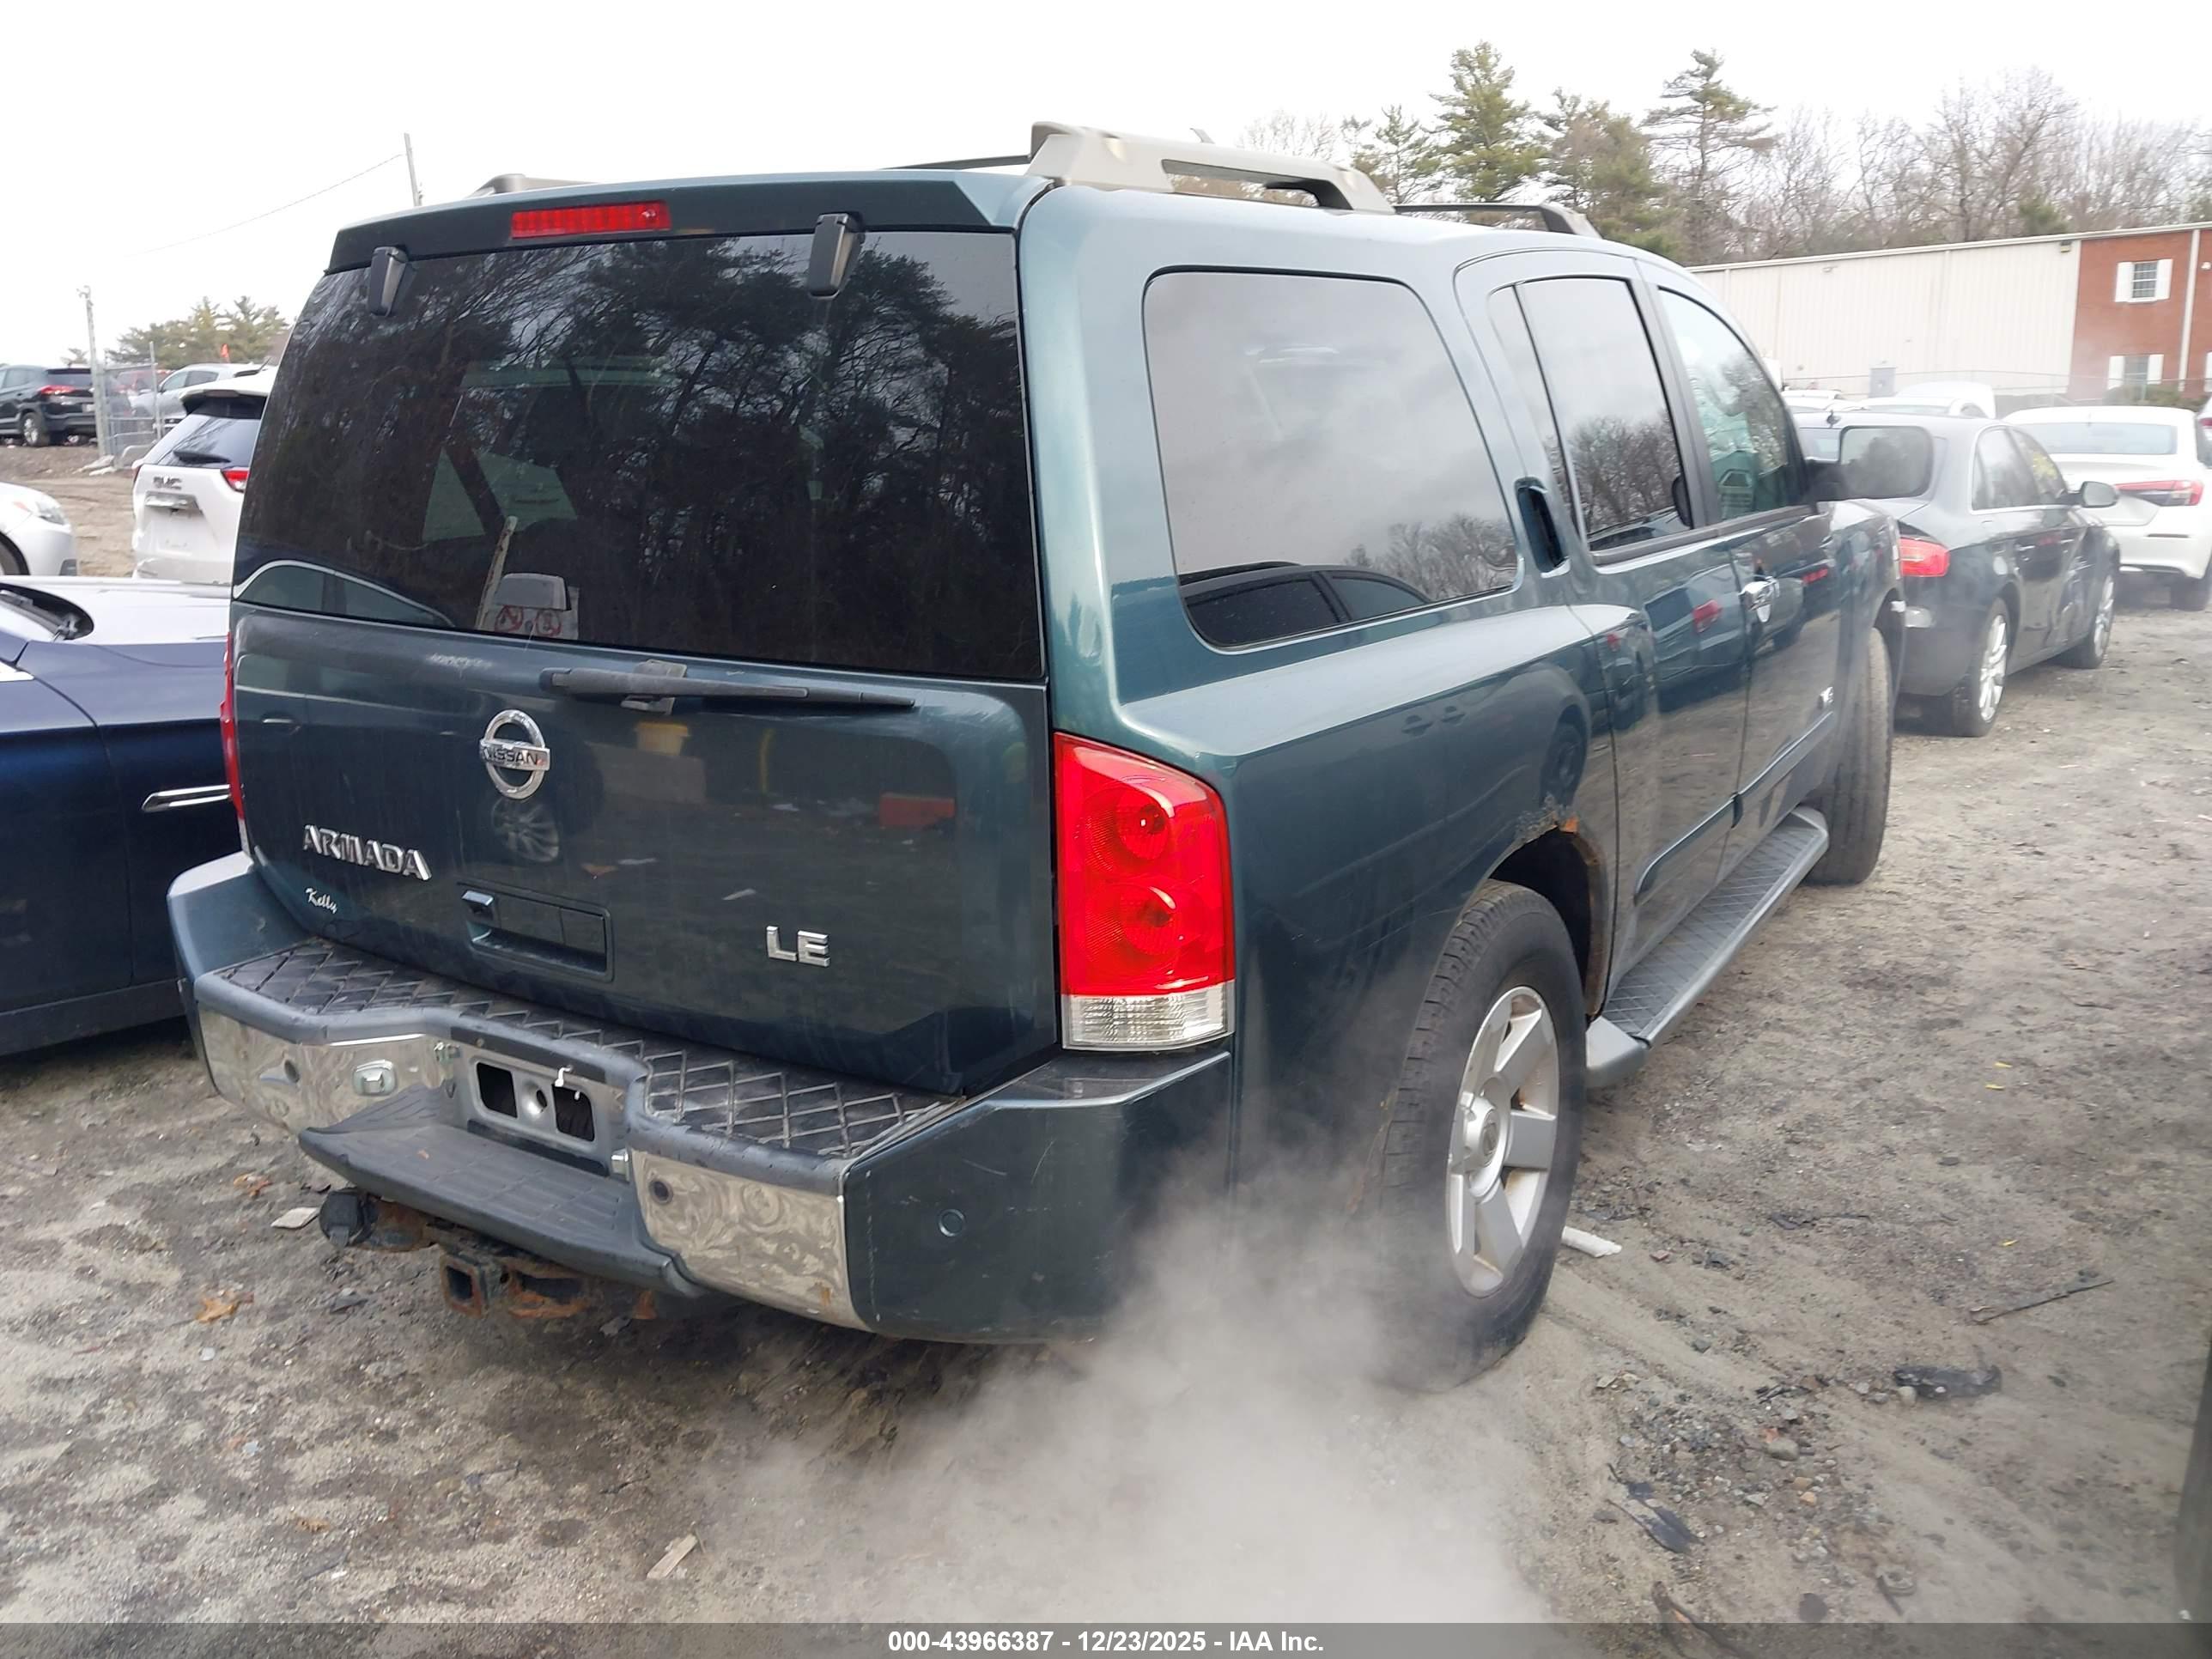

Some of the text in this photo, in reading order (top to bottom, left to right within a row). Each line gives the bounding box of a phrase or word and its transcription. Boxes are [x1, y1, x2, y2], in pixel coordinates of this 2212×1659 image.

[482, 744, 539, 767] NISSAN
[303, 824, 432, 881] ARMADA
[305, 887, 337, 914] Kelly
[766, 925, 830, 967] LE
